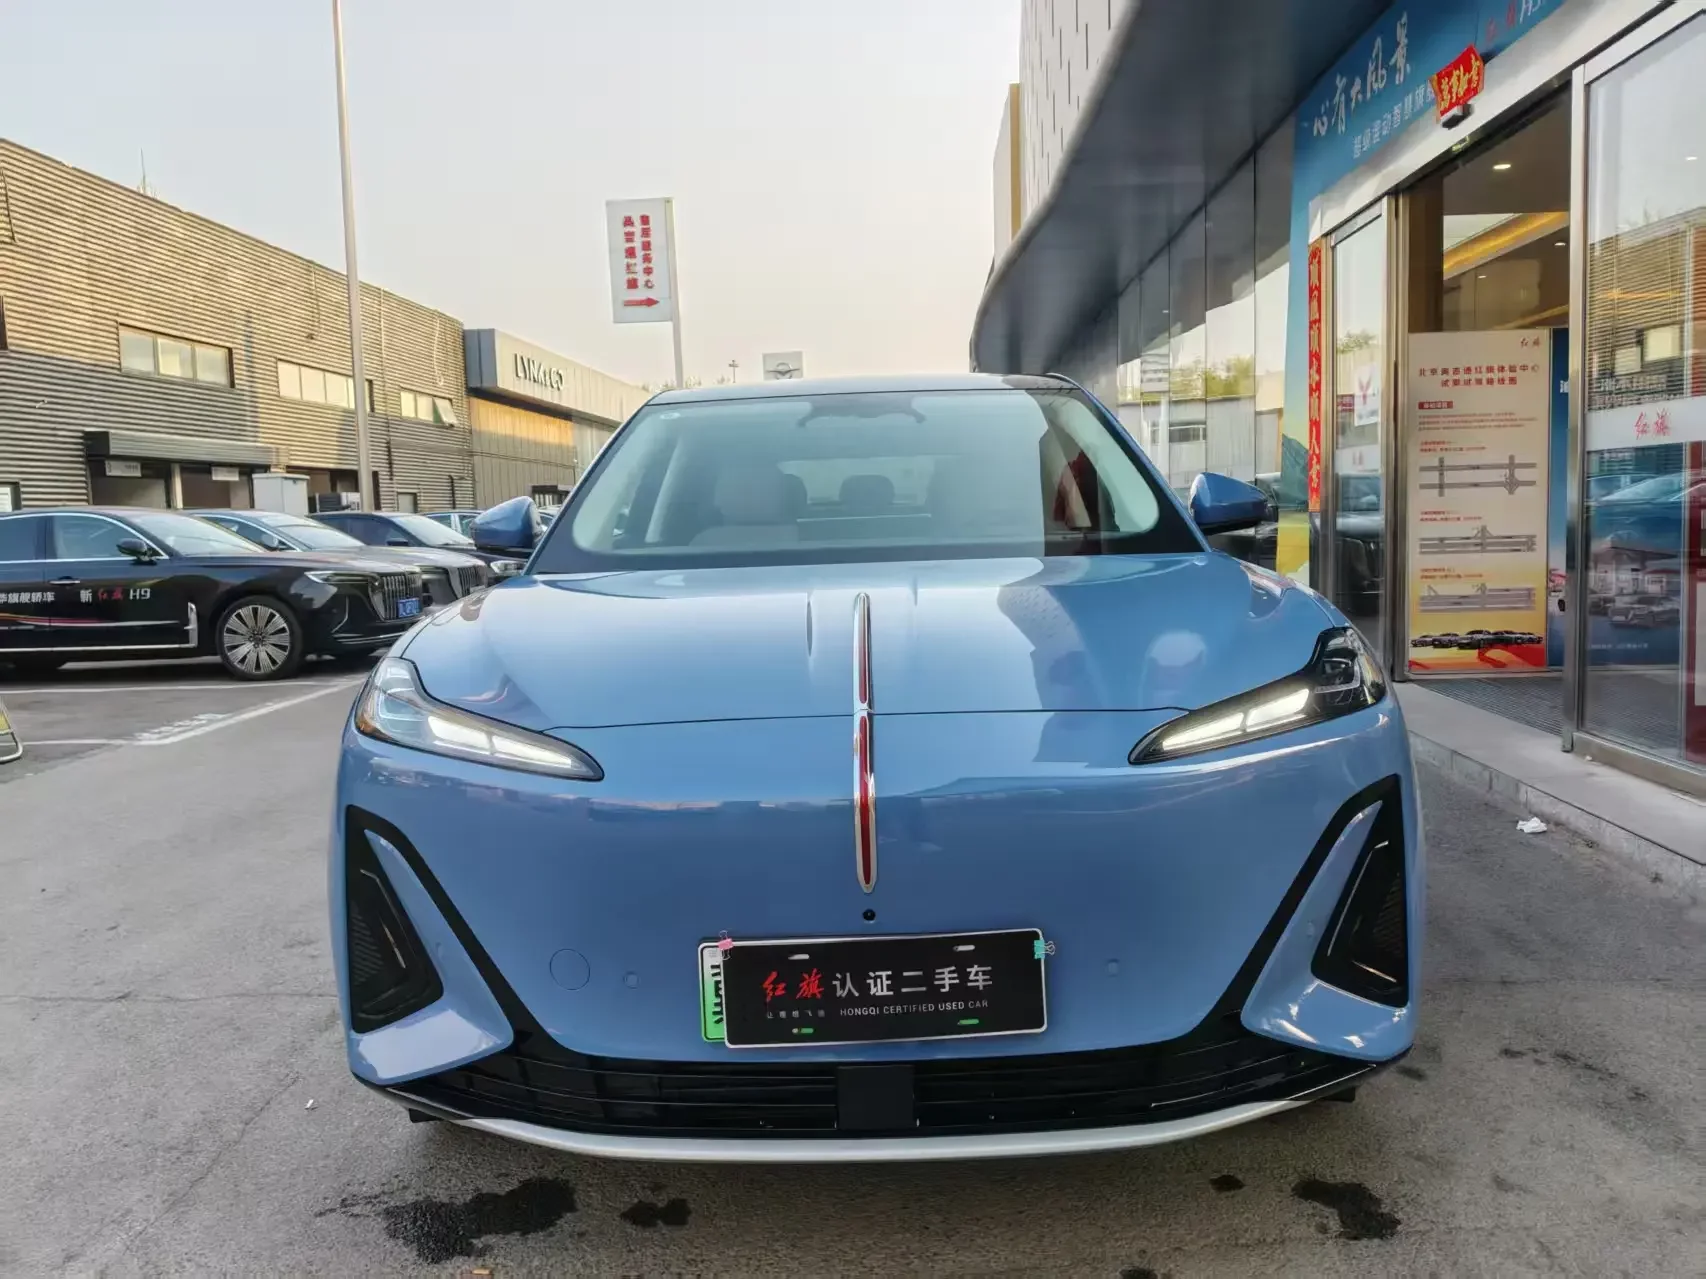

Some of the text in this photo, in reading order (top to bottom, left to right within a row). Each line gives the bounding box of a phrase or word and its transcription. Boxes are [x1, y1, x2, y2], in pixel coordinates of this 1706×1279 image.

[80, 589, 93, 603] 新
[129, 587, 151, 600] H9
[840, 1000, 989, 1017] HONGQI CERTIFIED USED CAR
